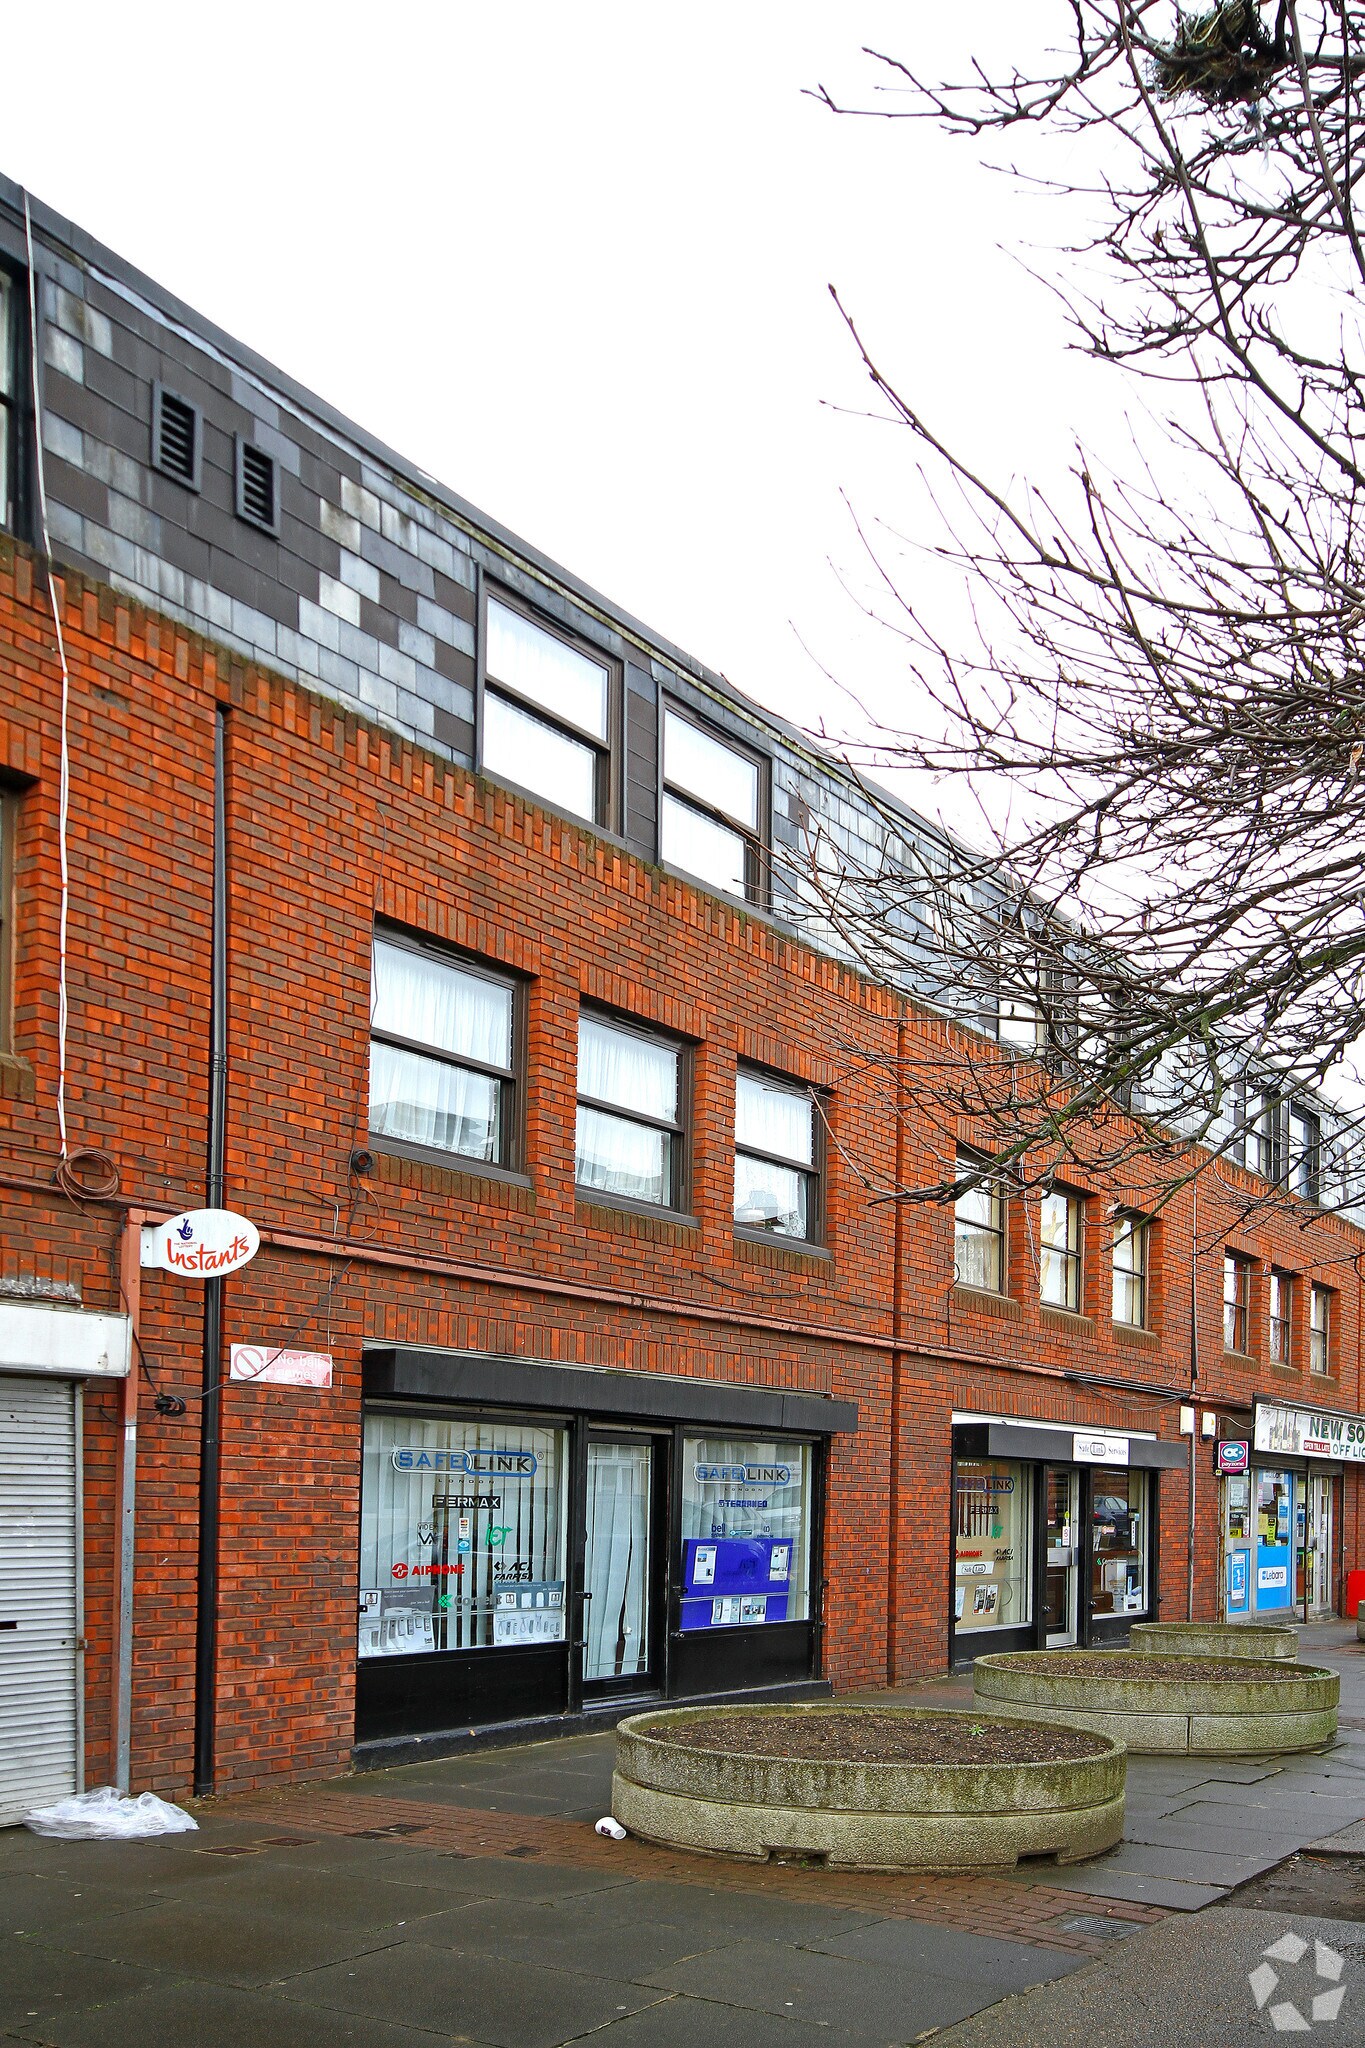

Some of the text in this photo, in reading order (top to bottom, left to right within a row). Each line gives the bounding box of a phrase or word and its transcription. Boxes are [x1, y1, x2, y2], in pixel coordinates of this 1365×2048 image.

[167, 1235, 250, 1271] Instants
[277, 1353, 321, 1368] No ball
[1308, 1416, 1365, 1444] NEW SO
[1304, 1441, 1313, 1450] OPEN
[1321, 1443, 1330, 1453] LATE
[1333, 1443, 1350, 1457] OFF
[399, 1451, 531, 1472] SAFE LINK
[697, 1467, 786, 1481] SAFE LINK
[987, 1480, 1011, 1490] LINK
[433, 1496, 500, 1508] FERMAX
[711, 1523, 726, 1533] bell
[411, 1563, 465, 1576] AIPHONE
